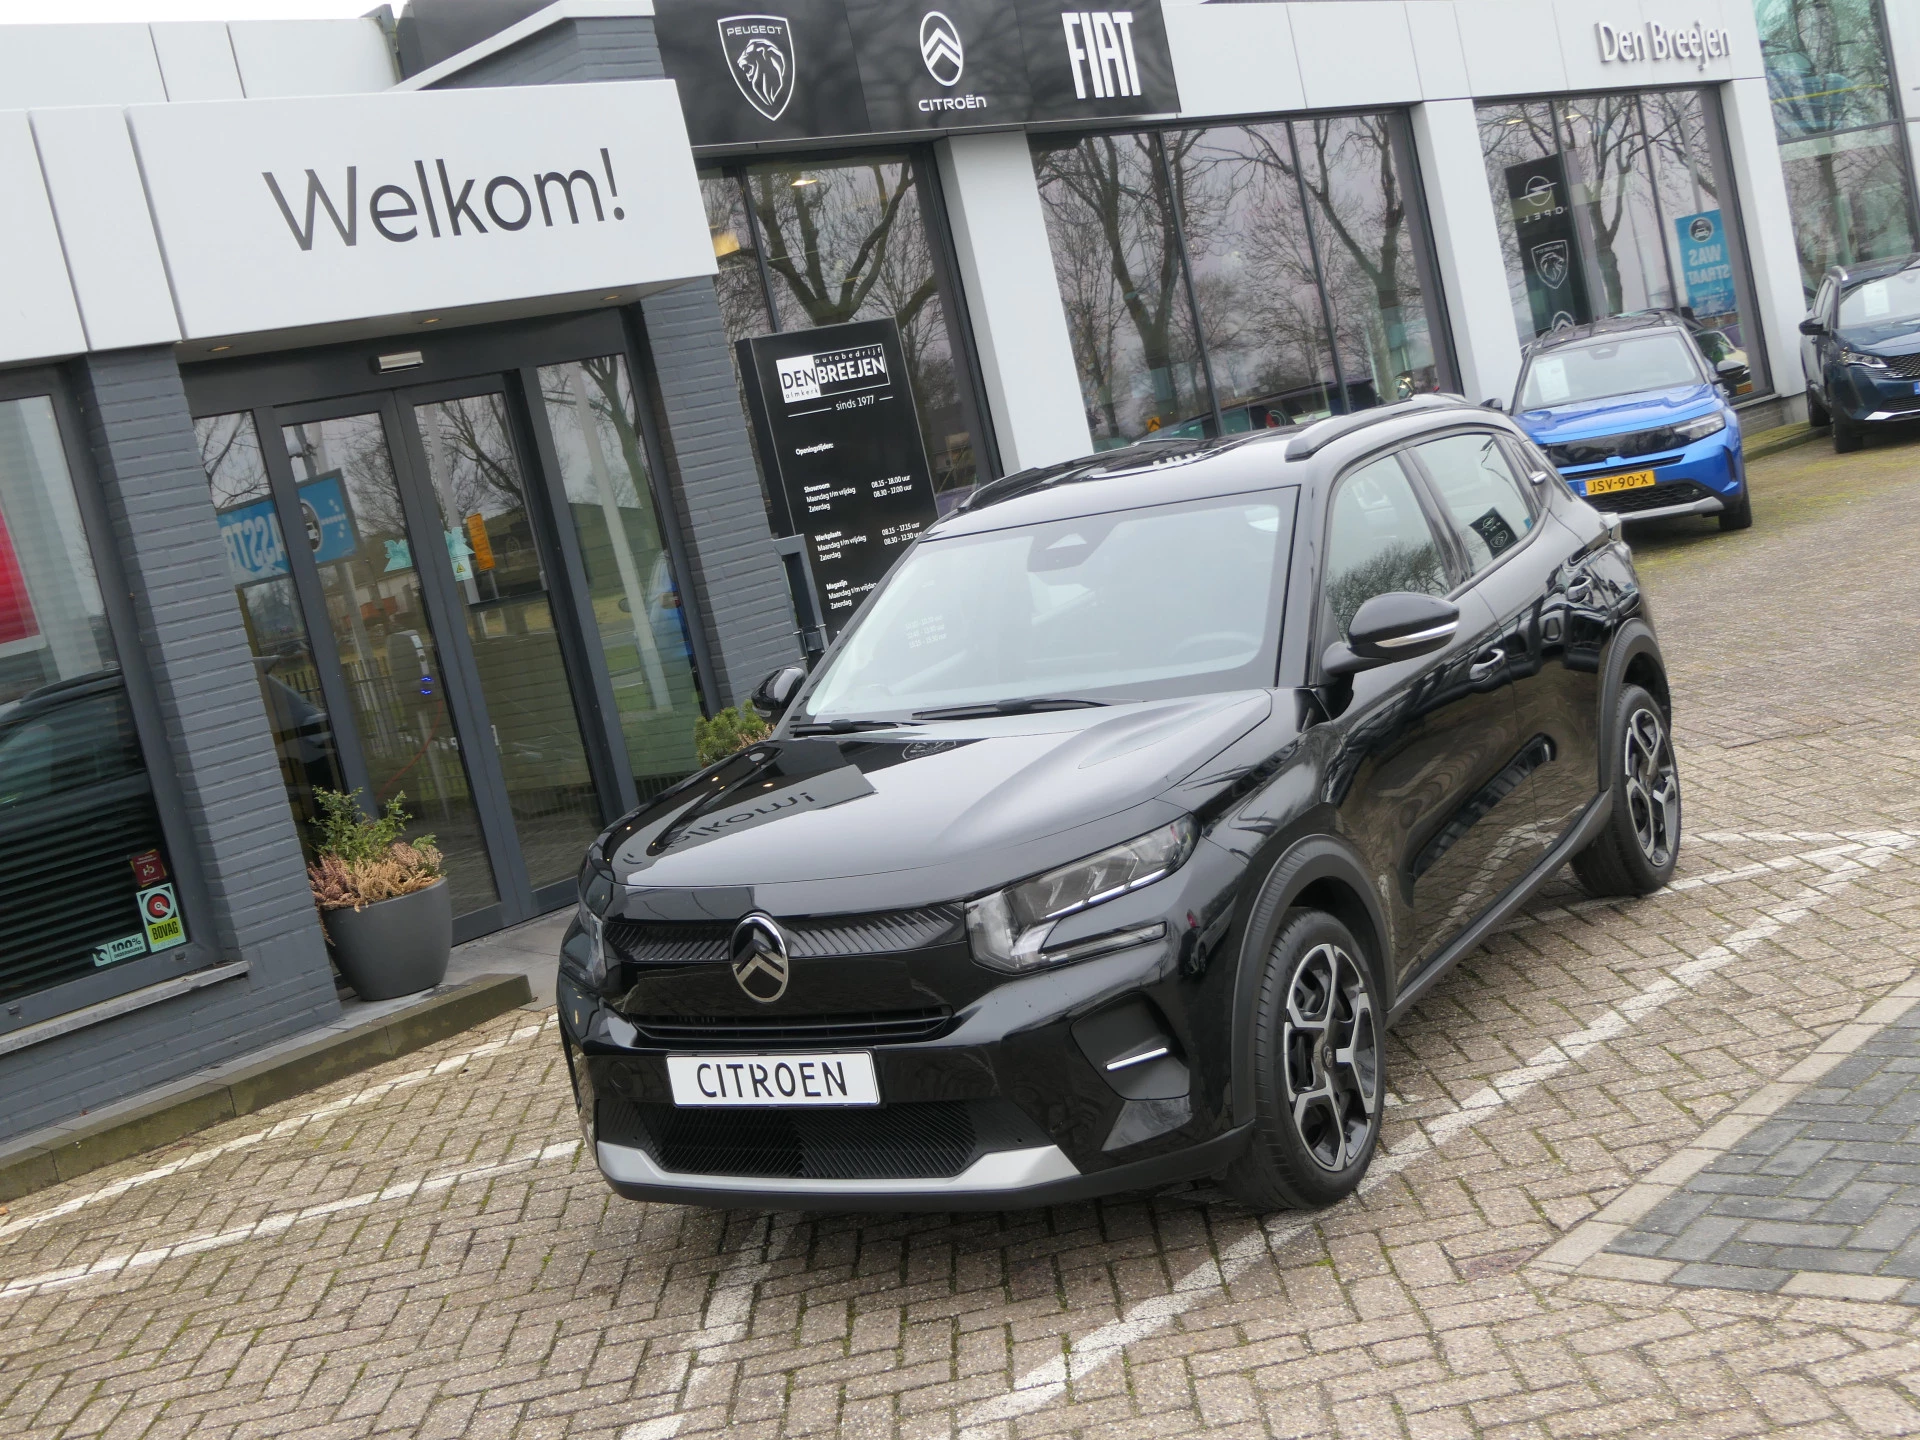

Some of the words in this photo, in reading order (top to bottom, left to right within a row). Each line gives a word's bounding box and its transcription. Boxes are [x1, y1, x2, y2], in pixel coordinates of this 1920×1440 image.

[726, 24, 783, 37] PEUGEOT
[1594, 22, 1646, 63] Den
[1647, 20, 1731, 73] Breejen
[1061, 11, 1142, 99] FIAT
[918, 94, 987, 112] CITROËN
[261, 148, 625, 251] Welkom!
[815, 347, 882, 364] autobedrijf
[781, 368, 817, 389] DEN
[816, 357, 886, 384] BREEJEN
[785, 388, 819, 399] almkerk
[835, 399, 857, 411] sinds
[857, 395, 874, 407] 1977
[804, 482, 830, 493] Showroom
[1590, 473, 1648, 493] JSV-90-X
[806, 492, 830, 503] Maandag
[838, 487, 857, 498] vrijdag
[808, 503, 831, 513] Zaterdag
[815, 530, 842, 542] Werkplaats
[817, 541, 840, 552] Maandag
[849, 534, 867, 546] vrijdag
[819, 551, 842, 562] Zaterdag
[828, 589, 851, 600] Maandag
[830, 599, 852, 610] Zaterdag
[152, 922, 178, 940] BOVAG
[111, 938, 142, 951] 100%
[697, 1061, 848, 1098] CITROEN
